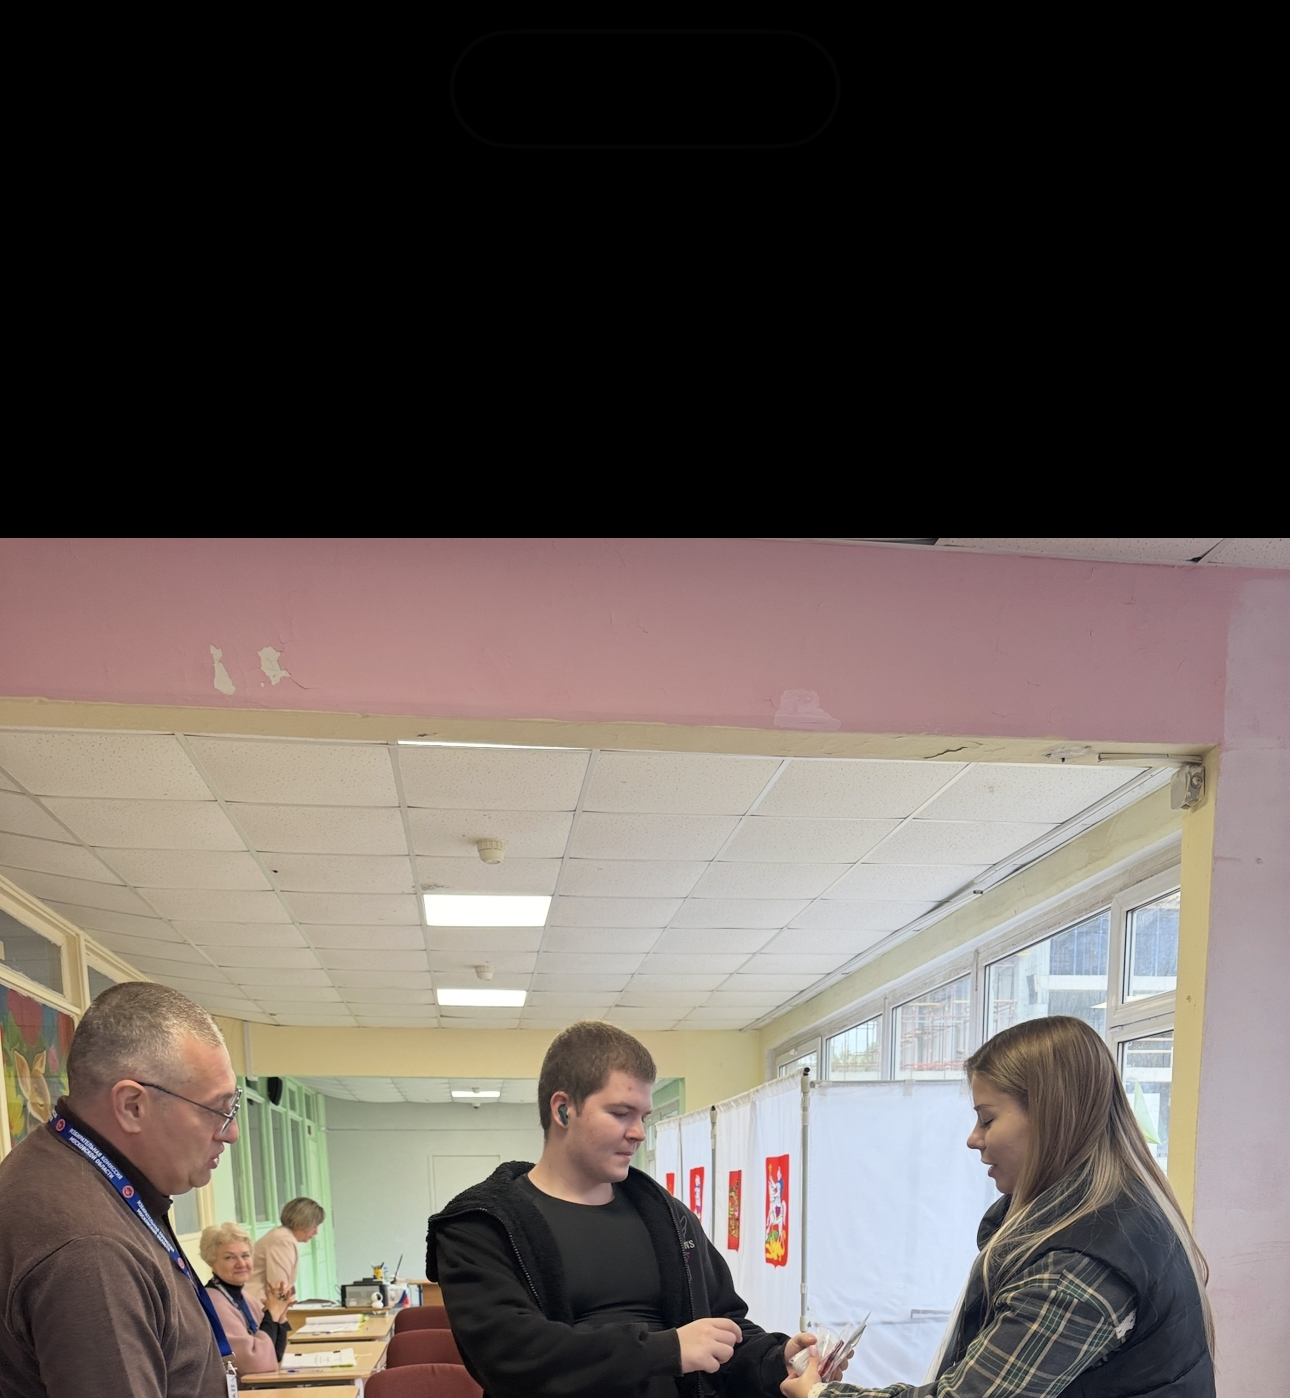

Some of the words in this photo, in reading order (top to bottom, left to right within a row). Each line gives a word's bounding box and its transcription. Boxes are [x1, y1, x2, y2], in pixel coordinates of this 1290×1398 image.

[69, 1127, 103, 1157] ИЗБИРАТЕЛЬНАЯ
[100, 1155, 123, 1180] КОМИССИЯ
[69, 1136, 98, 1160] МОСКОВСКОЙ
[95, 1158, 115, 1180] ОБЛАСТИ
